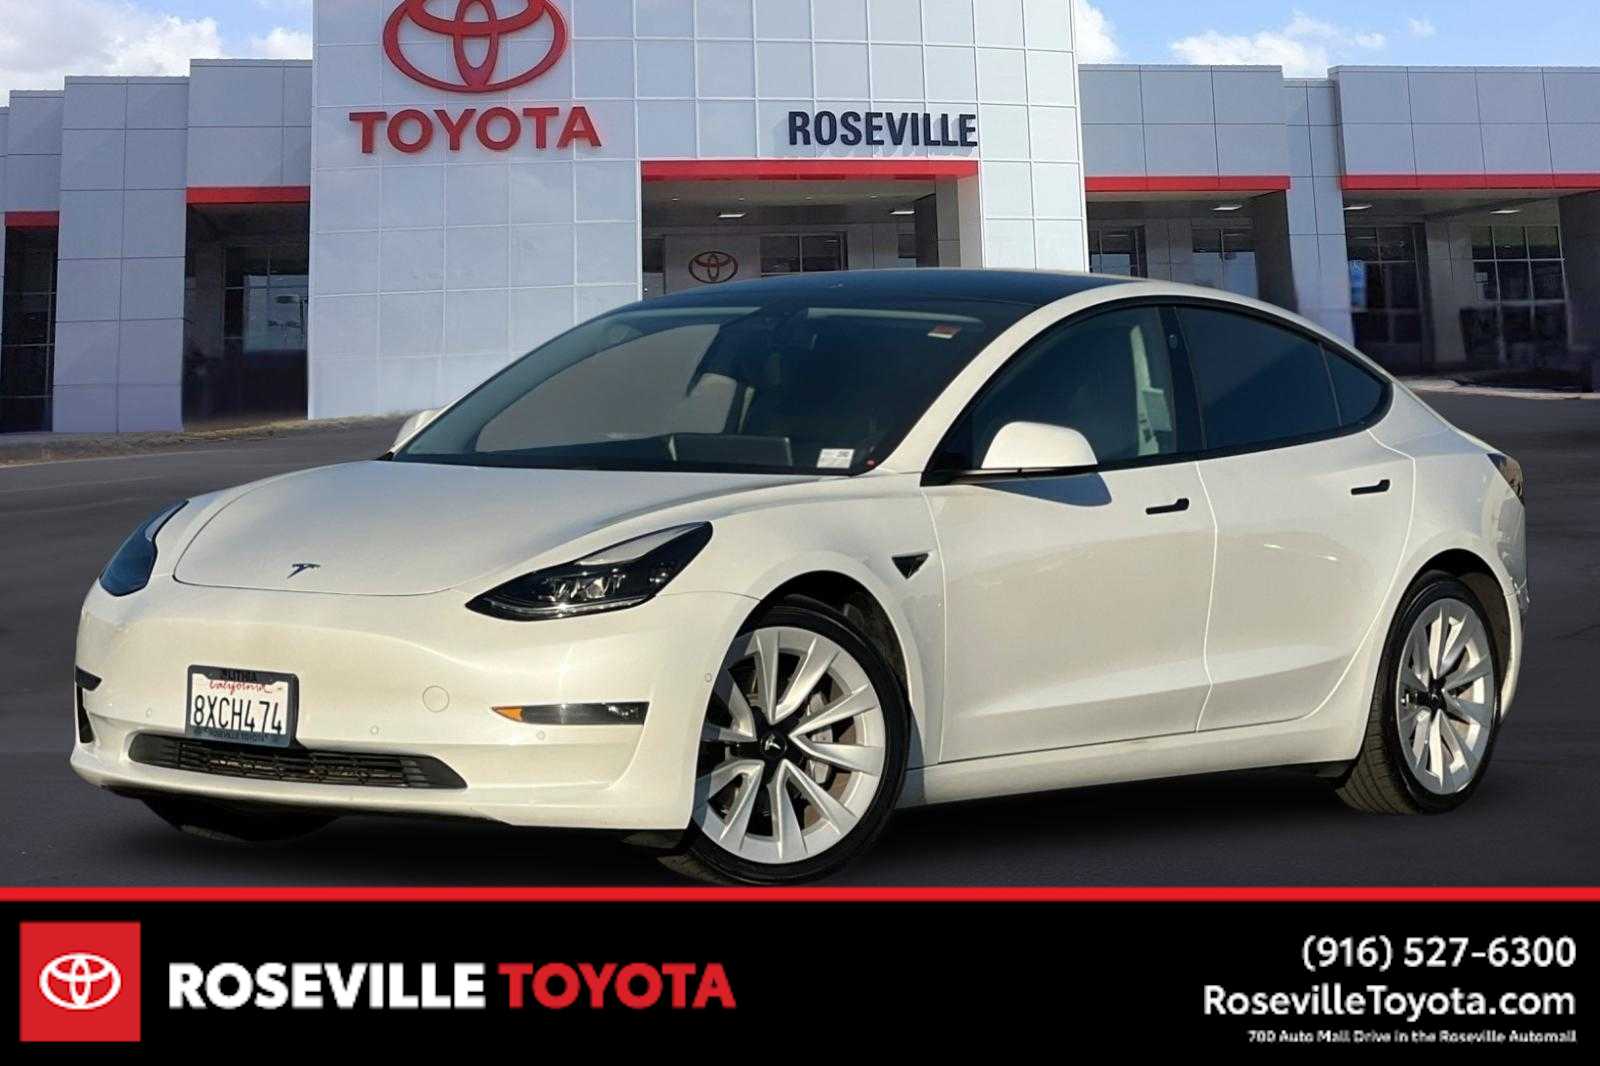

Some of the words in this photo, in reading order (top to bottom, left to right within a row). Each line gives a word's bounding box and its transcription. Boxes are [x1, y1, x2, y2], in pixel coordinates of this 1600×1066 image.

[349, 106, 602, 153] TOYOTA
[788, 111, 978, 147] ROSEVILLE
[193, 694, 282, 735] 8XCH474
